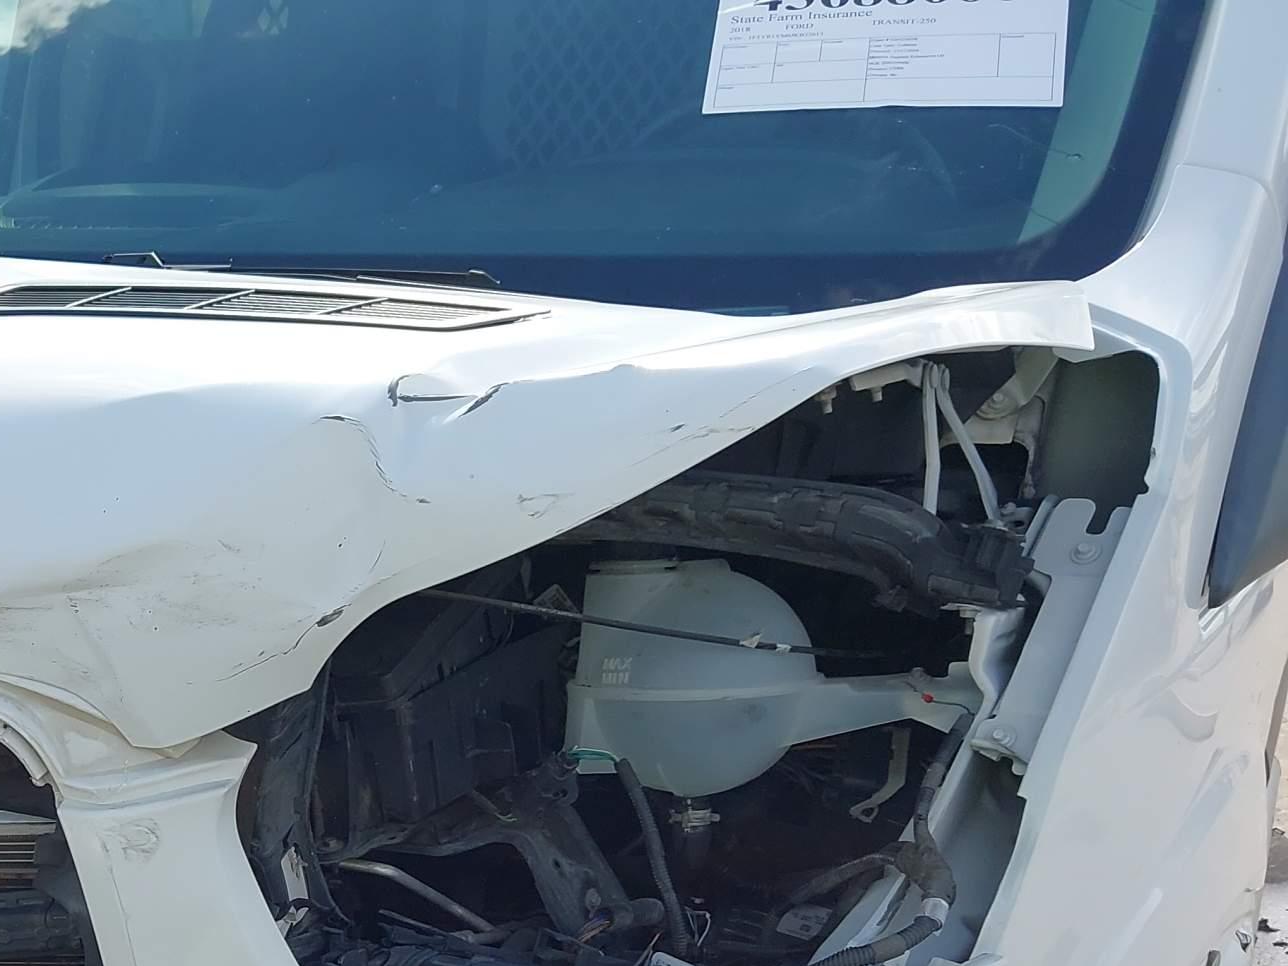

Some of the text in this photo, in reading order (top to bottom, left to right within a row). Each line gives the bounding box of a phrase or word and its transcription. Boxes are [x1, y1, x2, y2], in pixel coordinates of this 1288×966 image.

[730, 10, 873, 24] State Farm Insurance
[784, 23, 814, 31] FORD
[871, 17, 937, 26] TRANSIT-250
[602, 657, 633, 670] MAX
